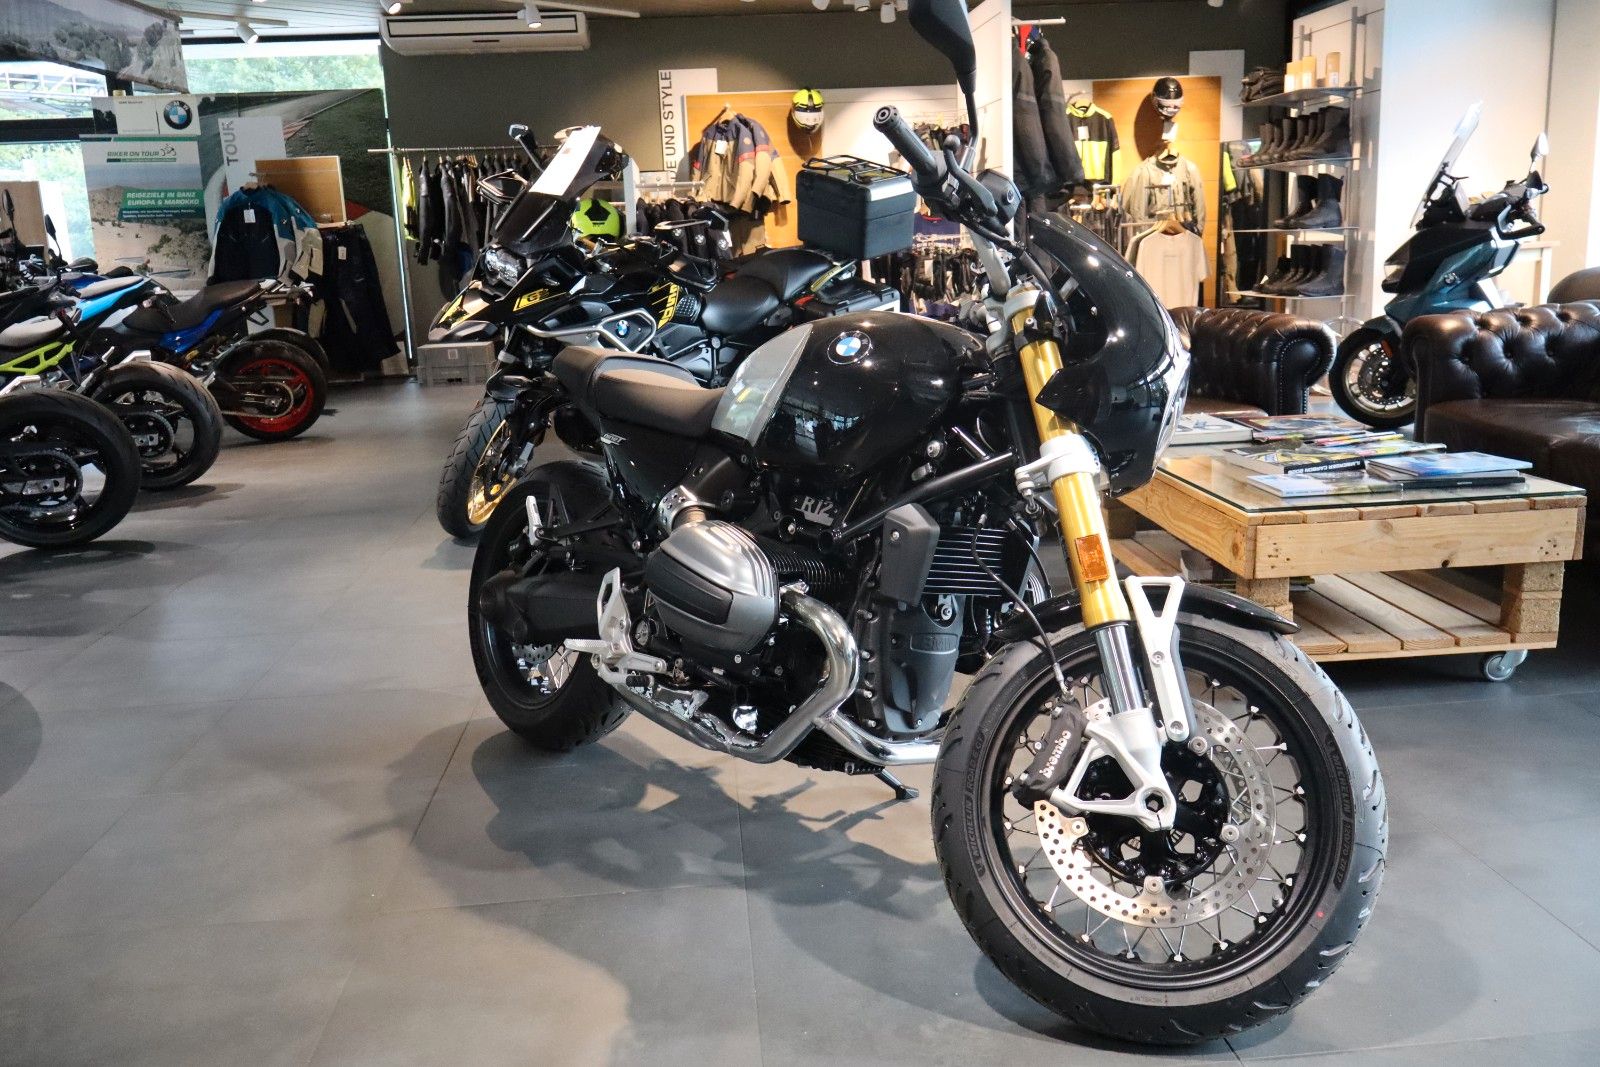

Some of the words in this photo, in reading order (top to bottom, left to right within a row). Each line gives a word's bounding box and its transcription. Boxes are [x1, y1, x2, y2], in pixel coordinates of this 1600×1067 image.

[660, 71, 674, 120] STYLE
[221, 120, 239, 167] TOUR
[664, 124, 676, 156] UND
[1304, 465, 1328, 473] CARBON
[1038, 730, 1072, 778] brembo
[1332, 753, 1351, 815] MICHELIN
[965, 799, 979, 861] MICHELIN
